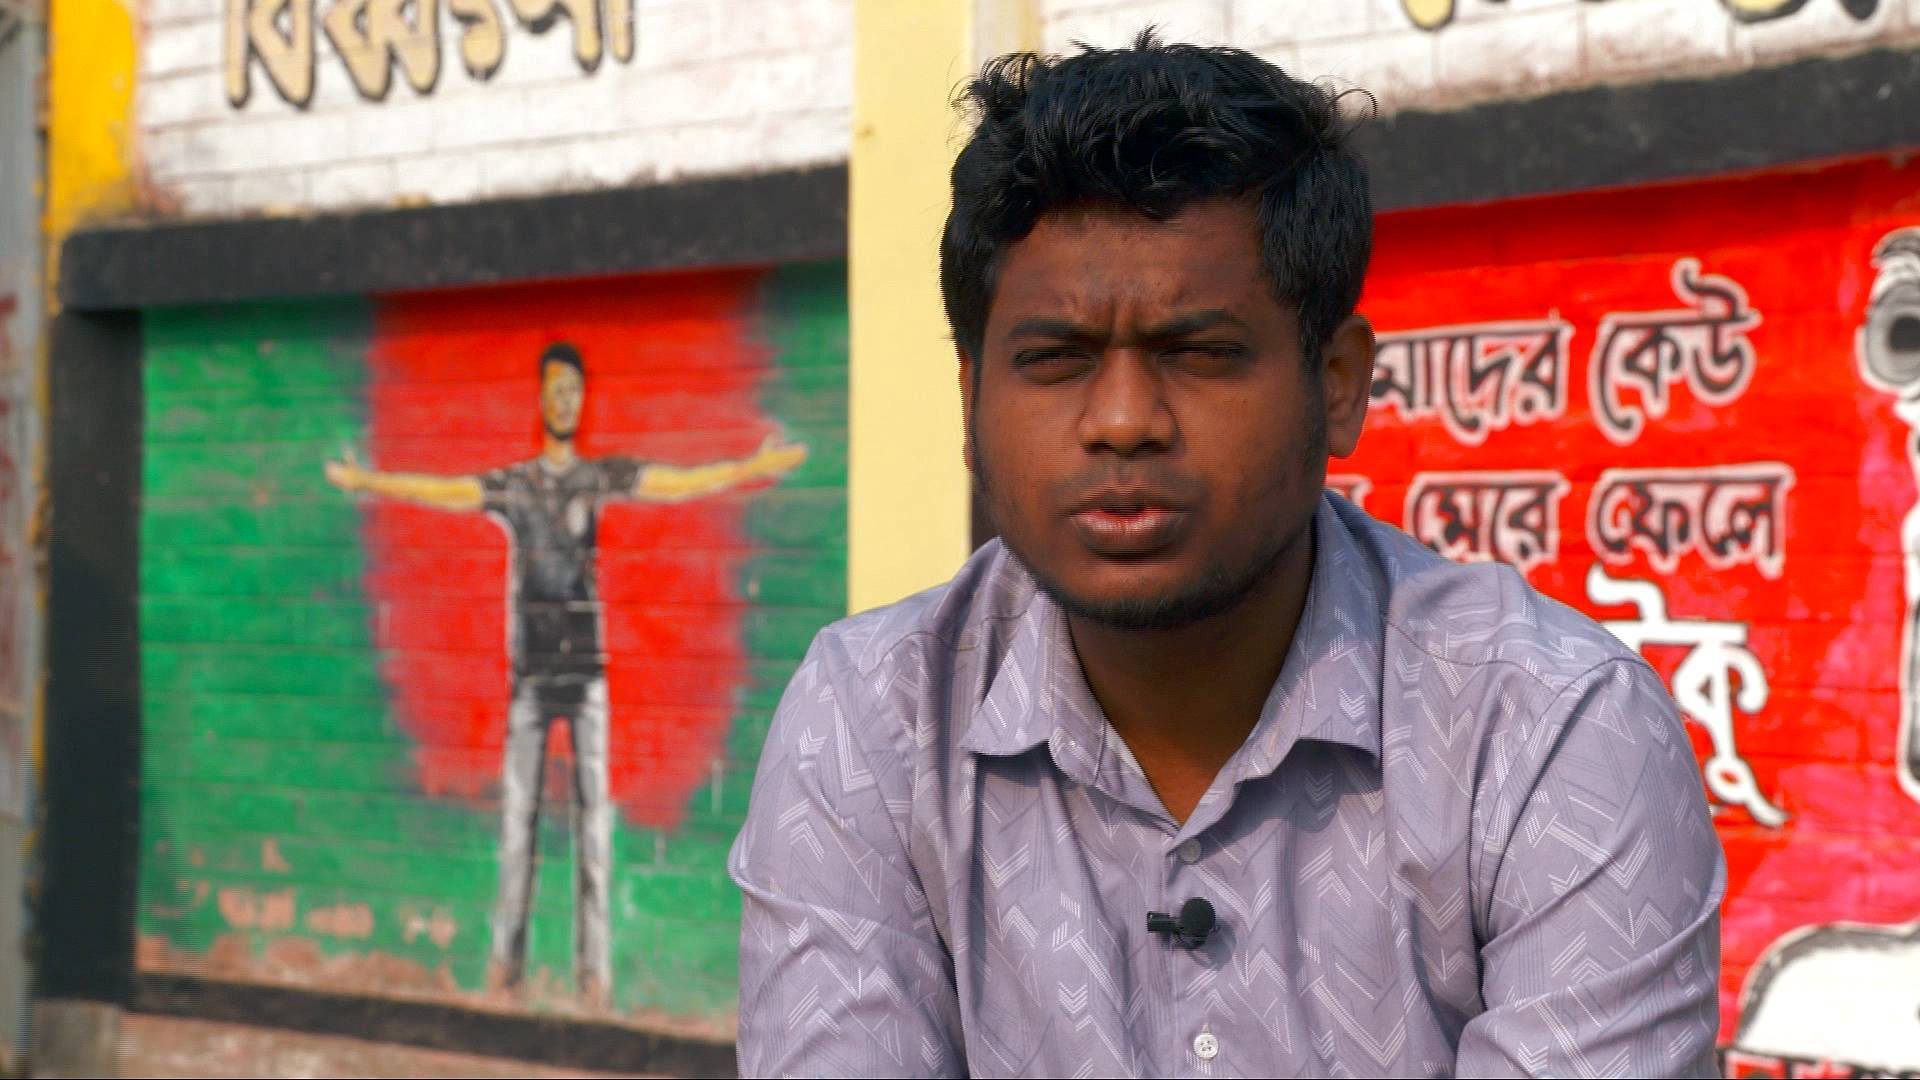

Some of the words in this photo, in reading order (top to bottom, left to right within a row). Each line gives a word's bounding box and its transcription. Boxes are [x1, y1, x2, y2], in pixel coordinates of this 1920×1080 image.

[1368, 310, 1576, 446] মাদের
[1588, 258, 1762, 446] কেউ
[1403, 468, 1571, 574] মেরে
[1585, 460, 1796, 581] ফেলে
